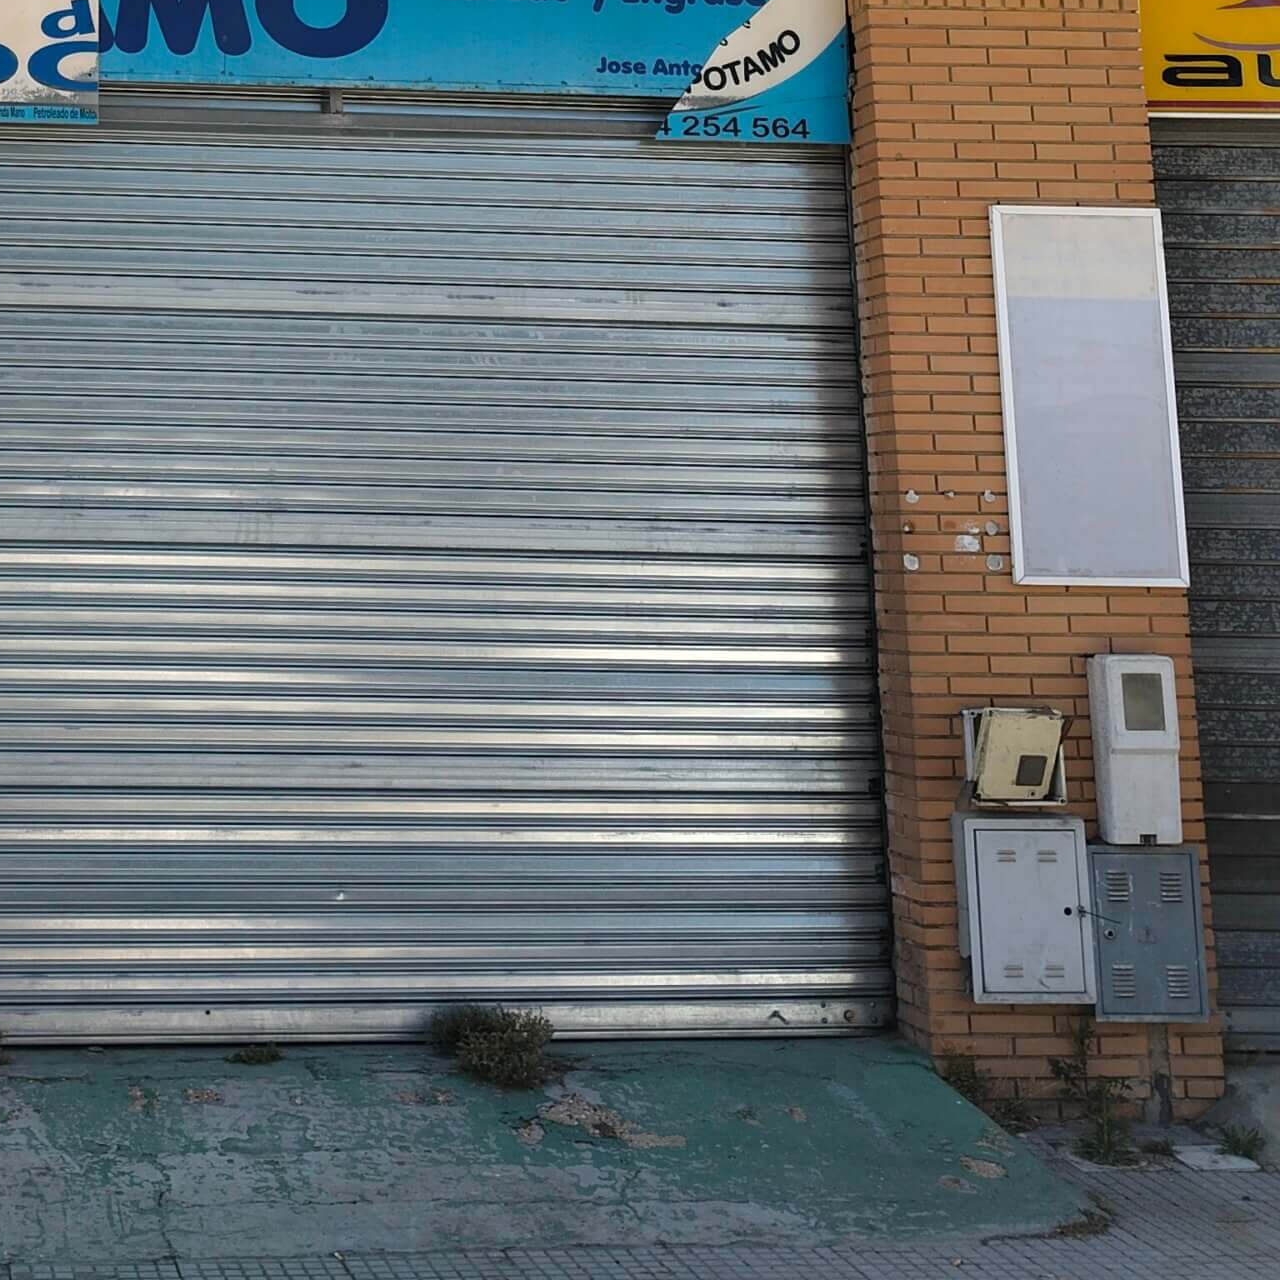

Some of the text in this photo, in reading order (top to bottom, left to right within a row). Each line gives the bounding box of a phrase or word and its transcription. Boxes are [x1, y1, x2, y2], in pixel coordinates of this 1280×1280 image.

[596, 57, 647, 76] Jose
[70, 108, 78, 119] de
[683, 116, 741, 137] 254
[752, 118, 810, 138] 564
